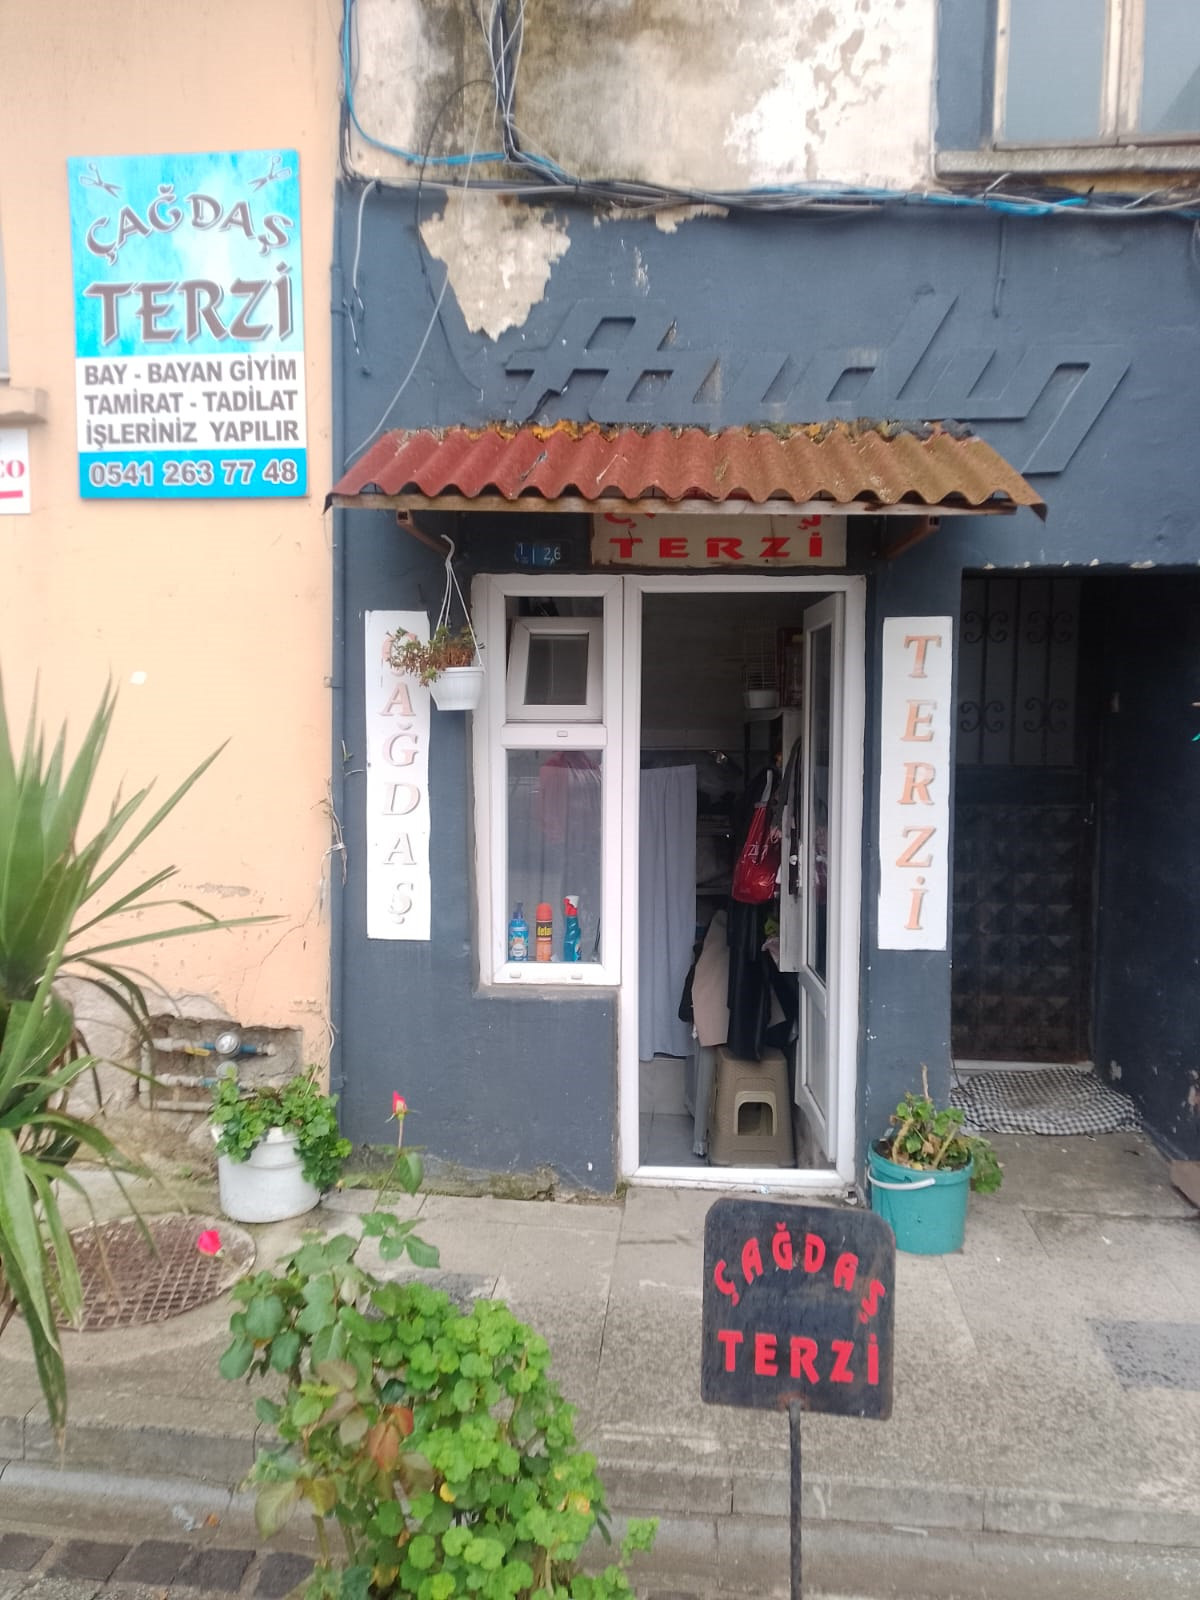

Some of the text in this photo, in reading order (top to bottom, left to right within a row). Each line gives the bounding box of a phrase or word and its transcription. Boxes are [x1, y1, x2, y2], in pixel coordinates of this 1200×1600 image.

[85, 184, 294, 265] ÇAĞDAŞ
[83, 261, 294, 346] TERZİ
[85, 364, 127, 387] BAY
[148, 361, 223, 384] BAYAN
[229, 354, 297, 382] GİYİM
[84, 388, 184, 415] TAMİRAT
[202, 385, 299, 412] TADİLAT
[85, 417, 300, 450] İŞLERİNİZ YAPILIR
[90, 459, 298, 487] 0541 263 77 48
[608, 531, 824, 561] TERZİ
[895, 633, 943, 932] TERZİ
[713, 1221, 886, 1325] ÇAĞDAŞ
[717, 1328, 880, 1386] TERZİ
